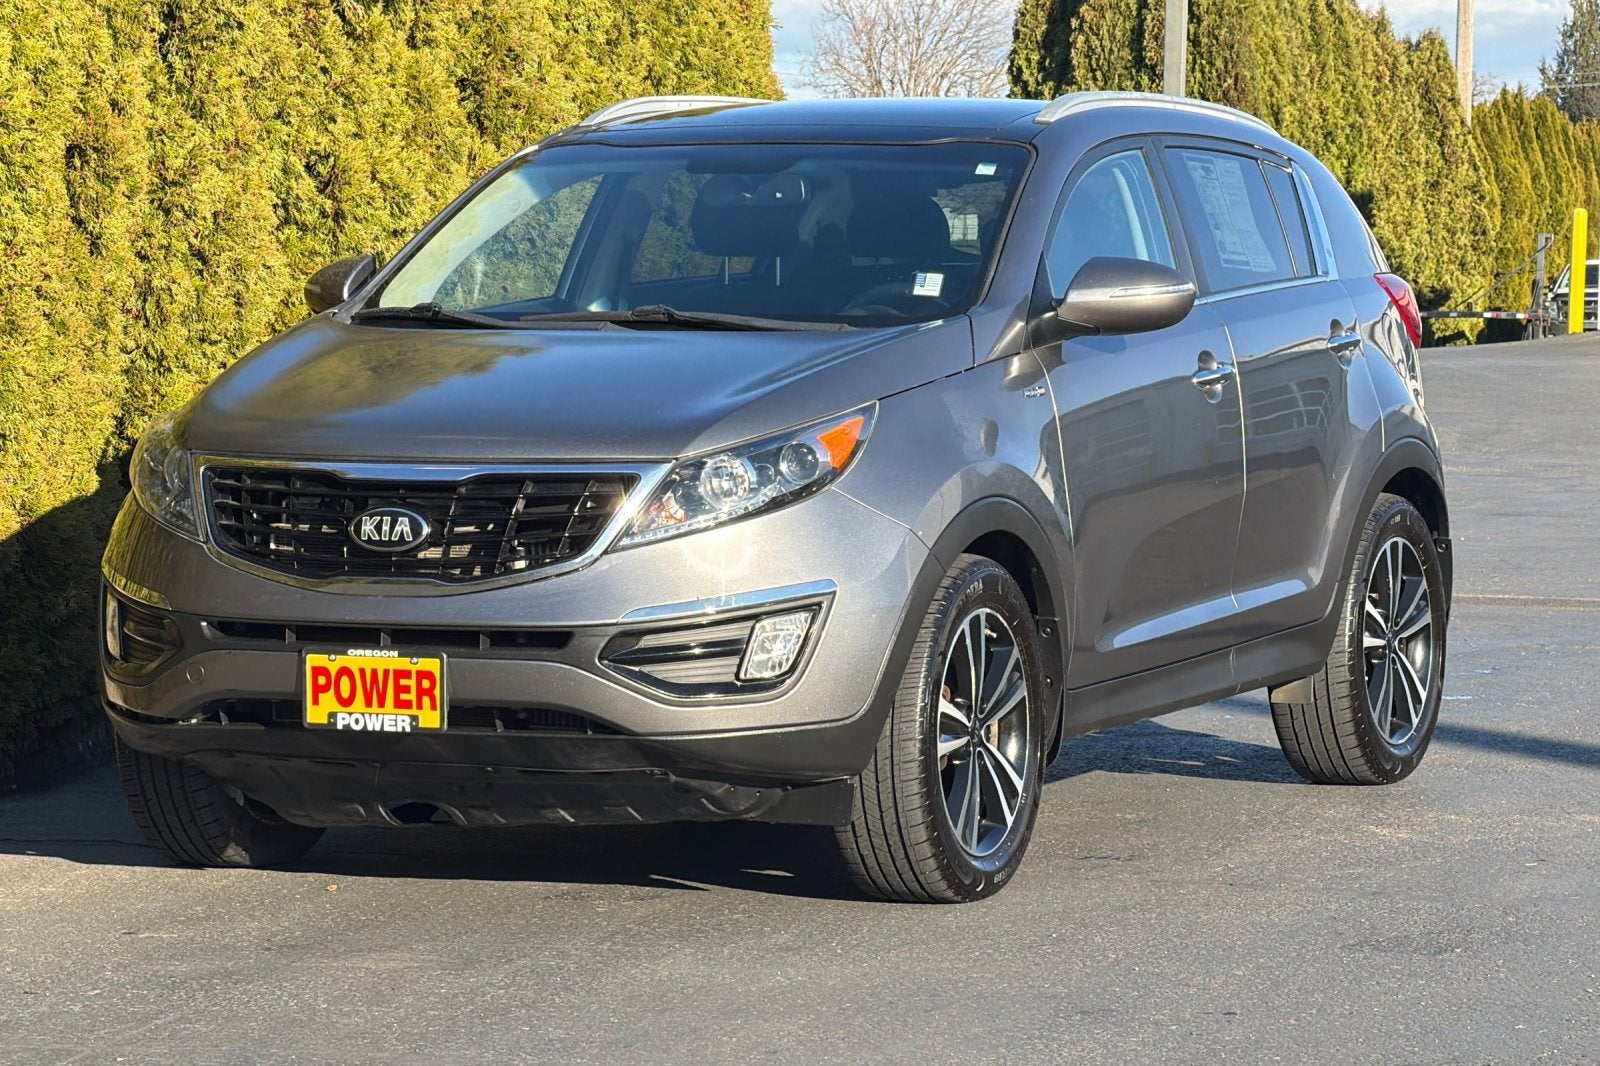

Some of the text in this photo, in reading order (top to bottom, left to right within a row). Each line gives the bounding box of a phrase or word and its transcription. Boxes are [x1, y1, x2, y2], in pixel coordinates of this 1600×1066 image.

[361, 516, 413, 541] KIA
[347, 649, 399, 658] OREGON
[311, 665, 438, 711] POWER
[336, 712, 411, 732] POWER
